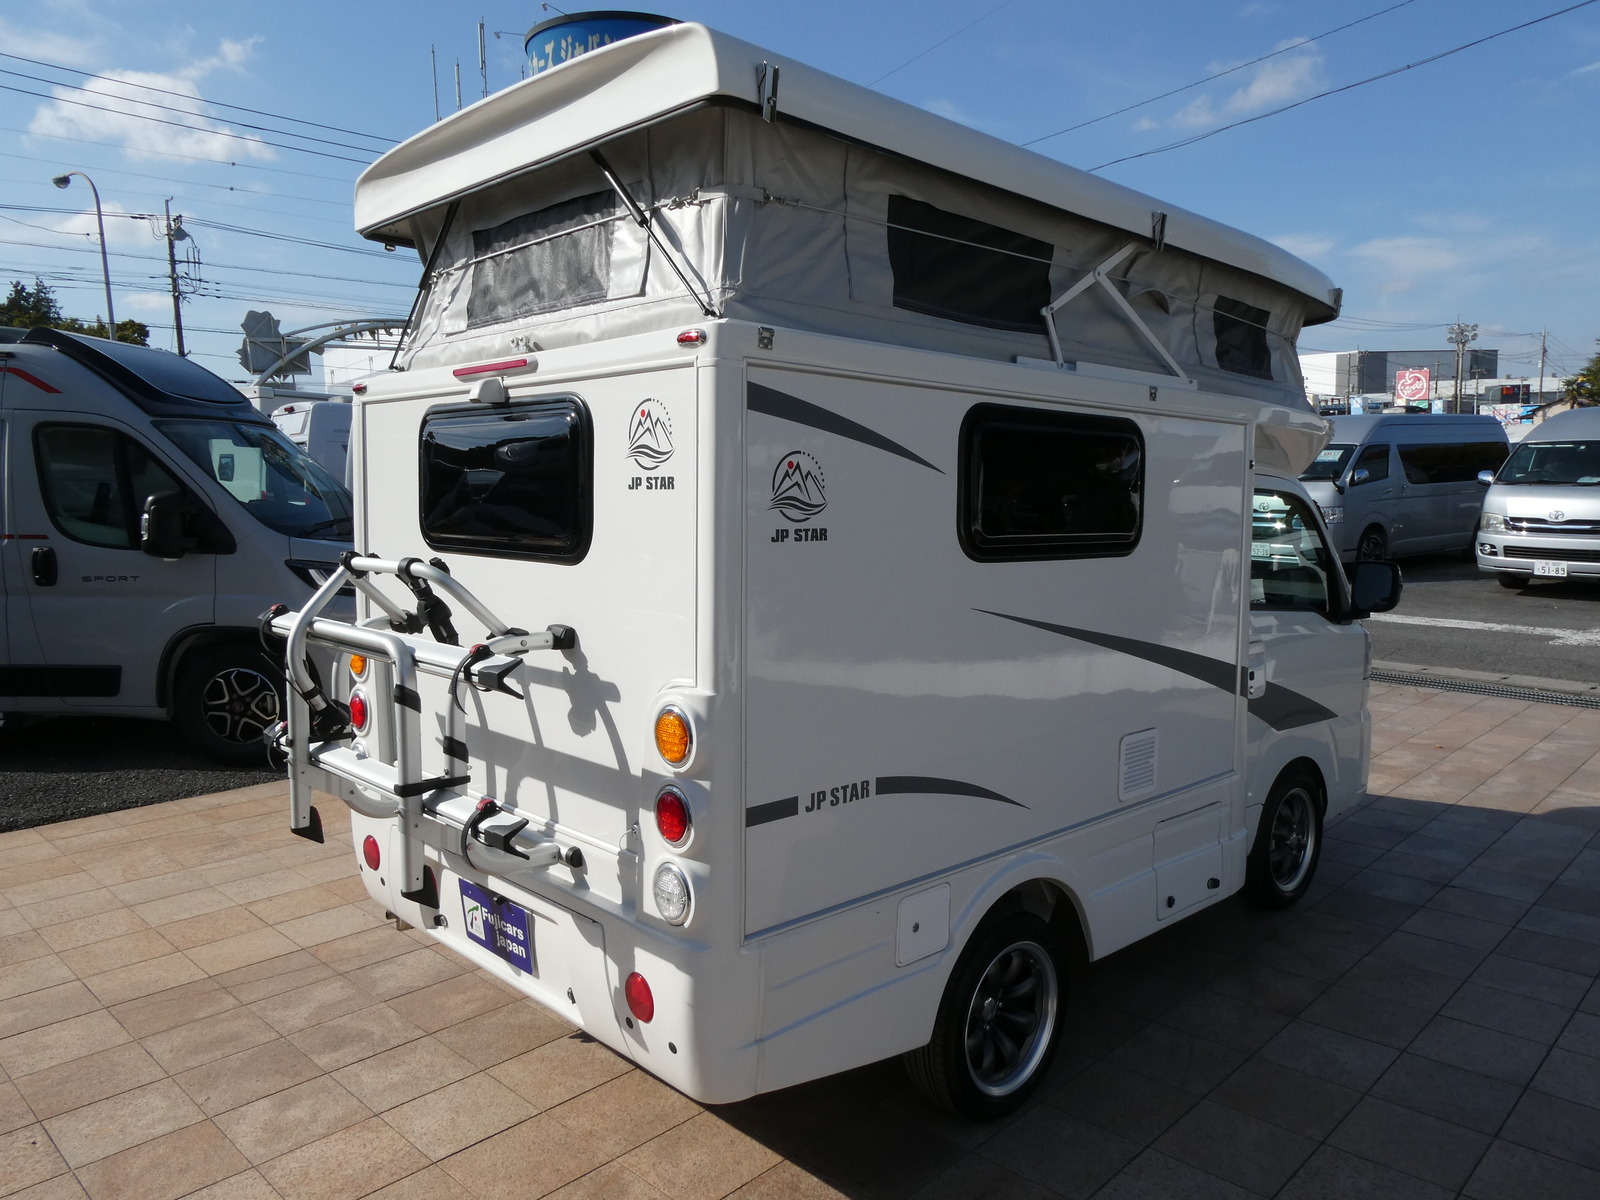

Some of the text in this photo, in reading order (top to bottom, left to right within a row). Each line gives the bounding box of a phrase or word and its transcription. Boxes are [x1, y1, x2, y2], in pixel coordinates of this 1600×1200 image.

[628, 476, 675, 490] JP STAR
[771, 528, 828, 543] JP STAR
[1541, 566, 1565, 575] 51-89
[81, 575, 140, 583] SPORT
[805, 780, 870, 813] JP STAR
[481, 906, 525, 941] Fujicars
